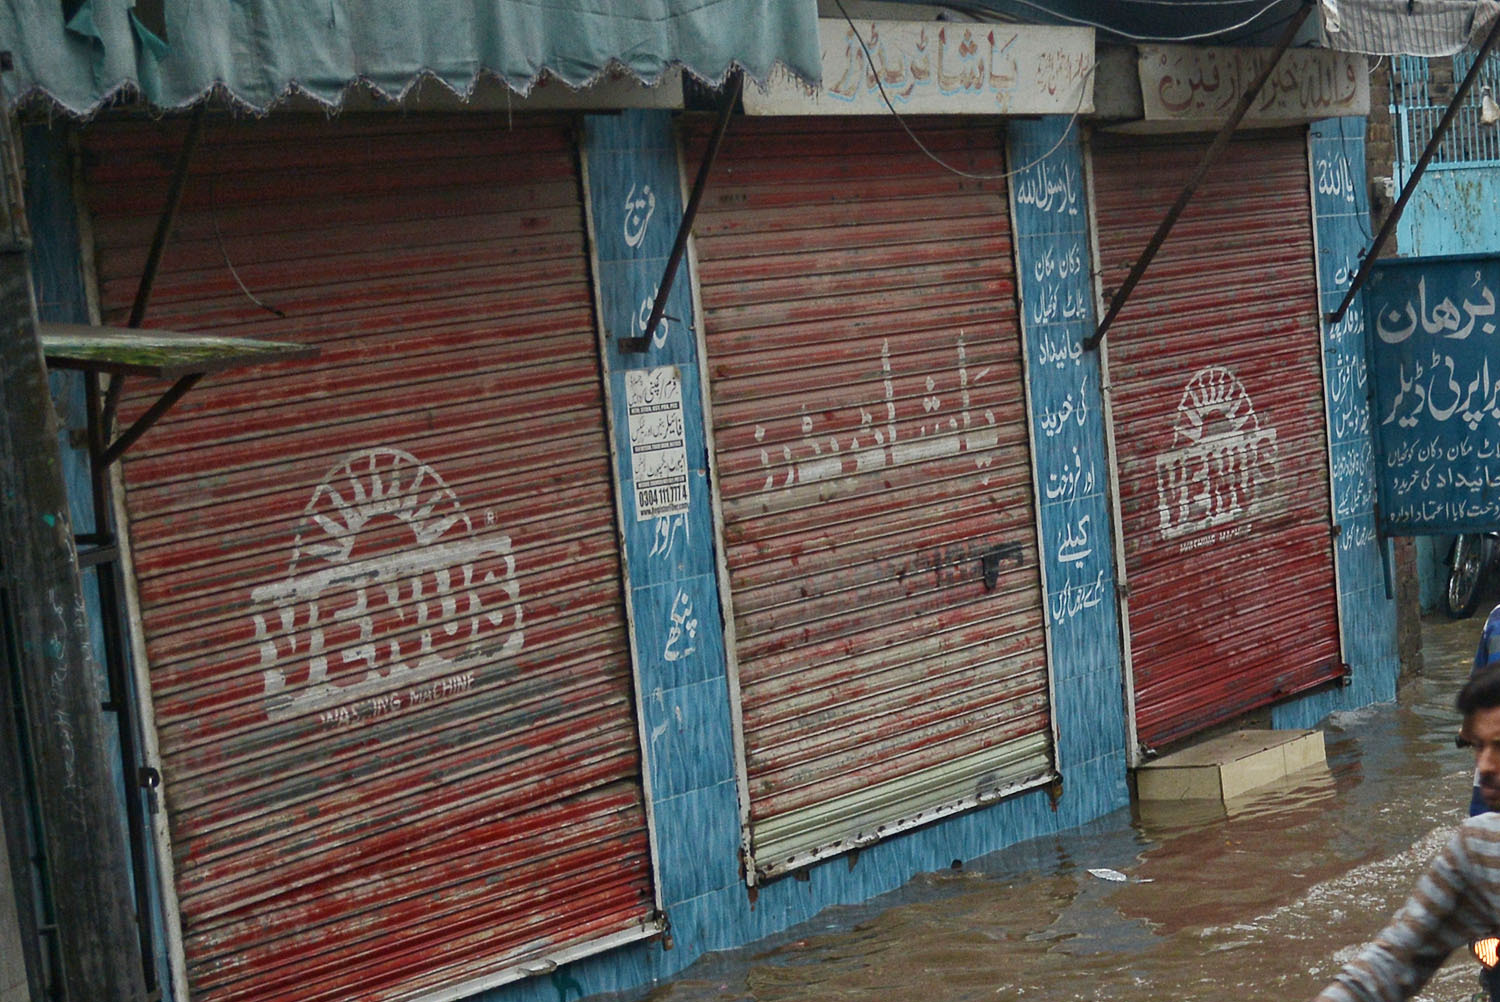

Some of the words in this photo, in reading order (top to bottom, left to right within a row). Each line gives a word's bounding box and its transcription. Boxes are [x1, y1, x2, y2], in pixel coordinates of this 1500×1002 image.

[624, 183, 656, 249] فریج
[1382, 360, 1428, 428] ڈیلر
[1041, 393, 1074, 437] خرید
[1418, 435, 1443, 462] دکان
[1446, 436, 1473, 461] مکان
[1046, 446, 1082, 511] فروخت
[1083, 460, 1096, 495] اور
[1421, 463, 1436, 491] کی
